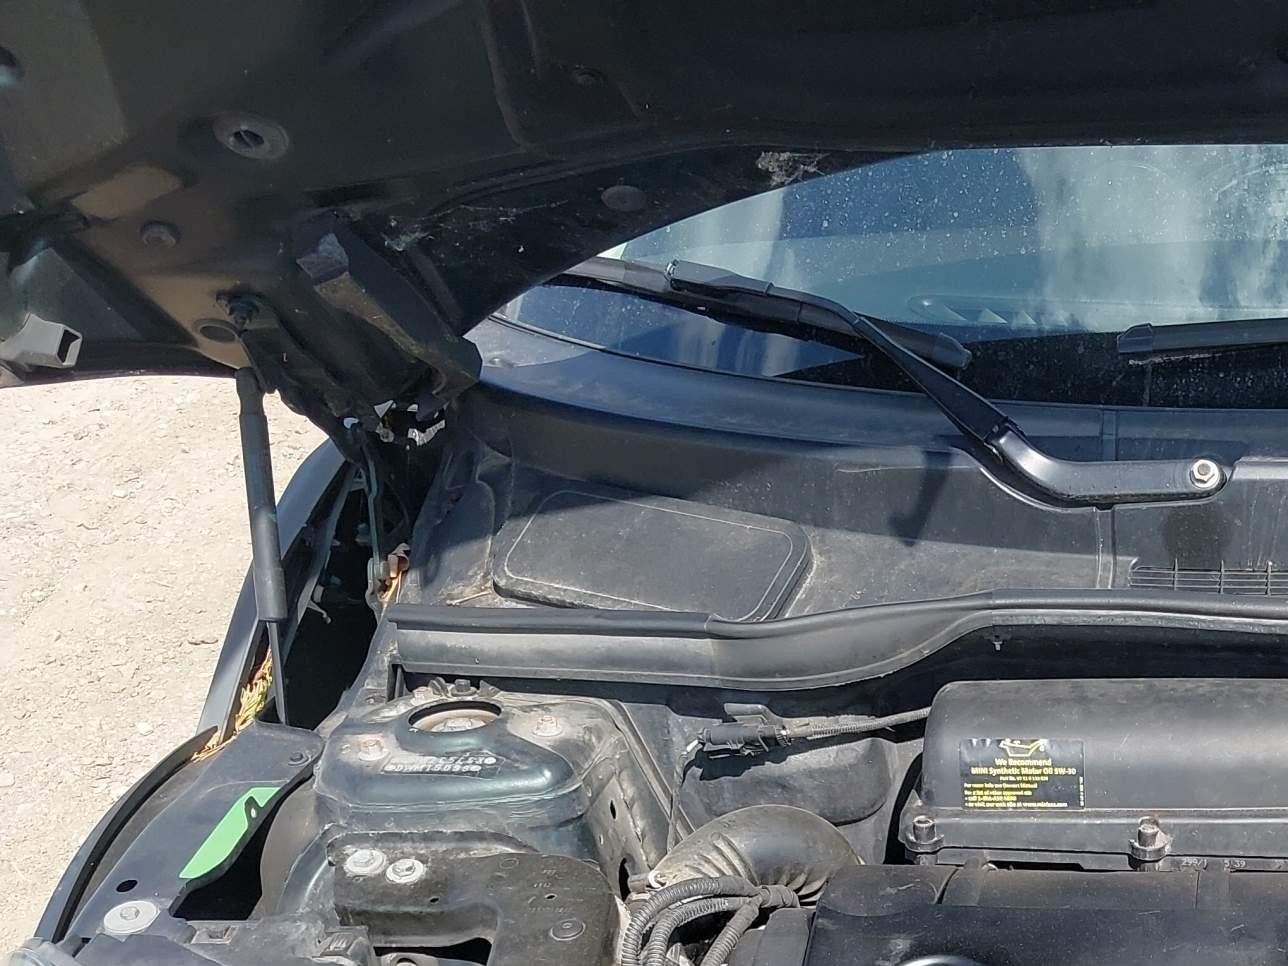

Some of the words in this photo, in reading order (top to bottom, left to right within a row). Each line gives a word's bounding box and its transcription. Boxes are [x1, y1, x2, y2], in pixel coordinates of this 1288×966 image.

[995, 758, 1008, 766] We
[1008, 758, 1052, 766] Recommend
[989, 767, 1020, 776] Synthetic
